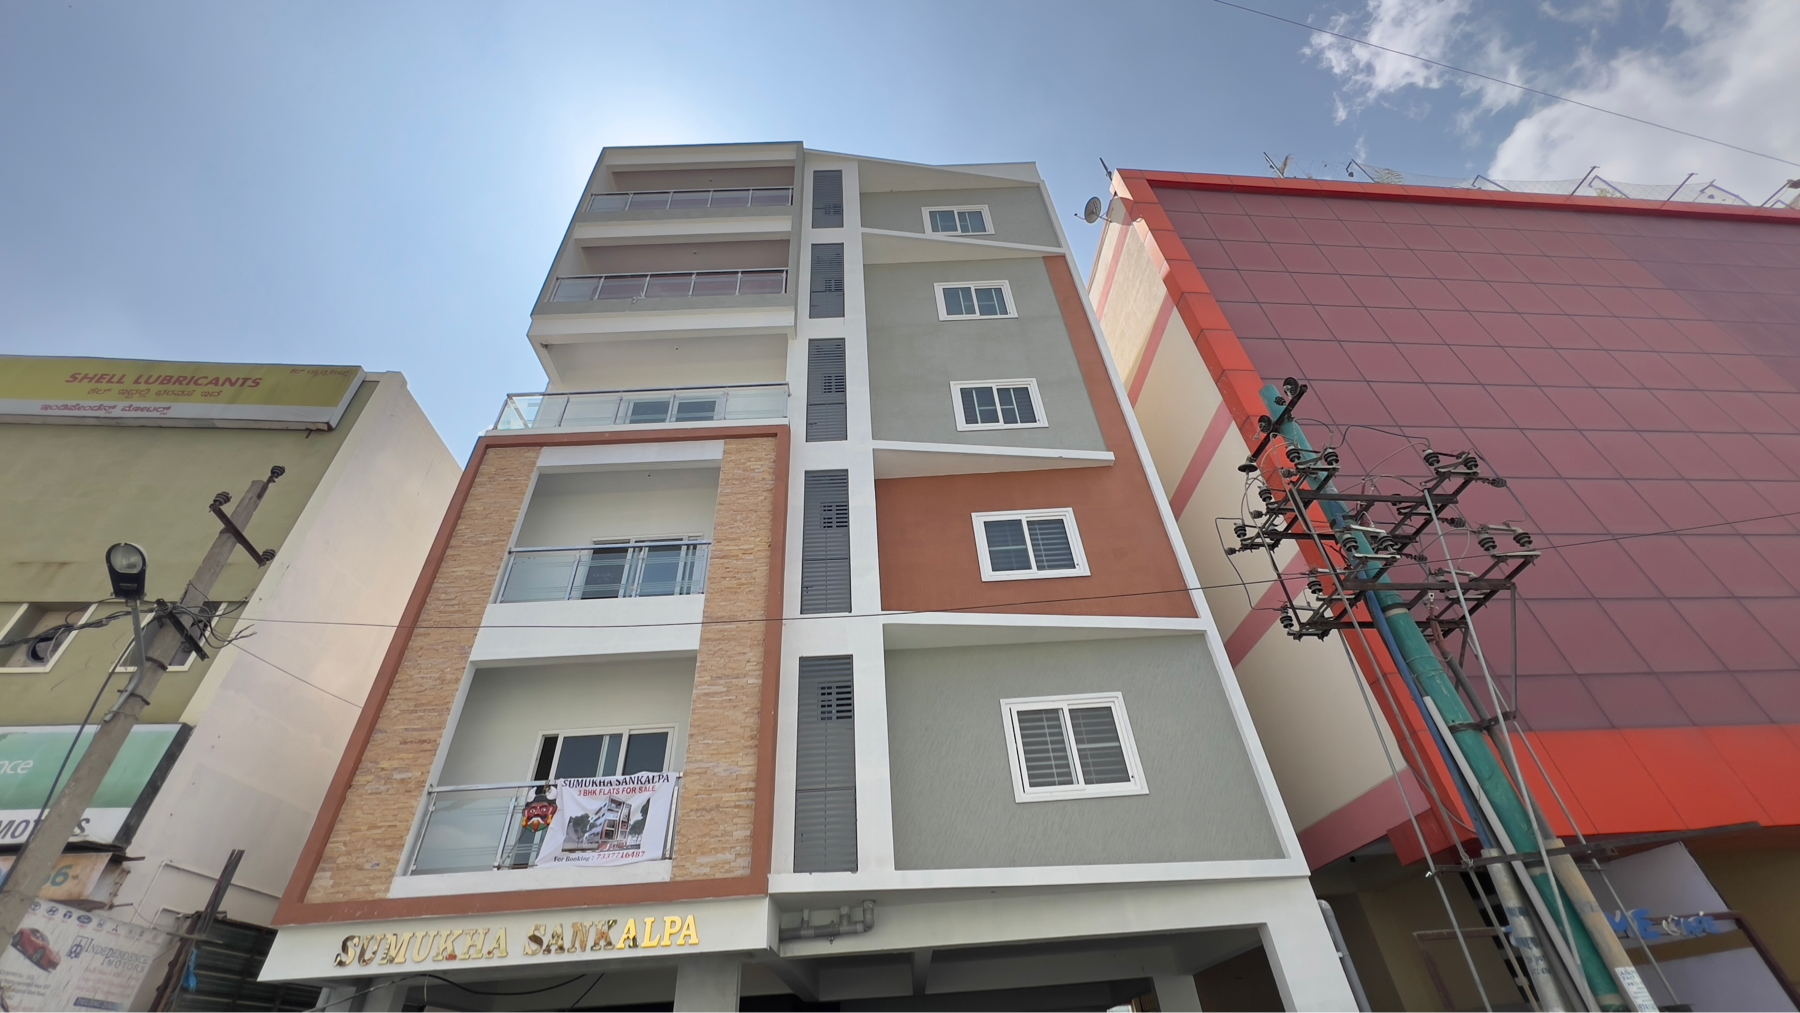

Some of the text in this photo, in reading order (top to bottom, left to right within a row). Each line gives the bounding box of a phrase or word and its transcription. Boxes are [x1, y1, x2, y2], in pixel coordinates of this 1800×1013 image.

[65, 372, 263, 388] SHELL LUBRICANTS
[562, 774, 670, 788] SUMUKHA SANKALPA
[583, 789, 598, 797] BHK
[599, 787, 621, 796] FLATS
[621, 786, 637, 795] FOR
[638, 785, 656, 793] SALE
[565, 855, 590, 864] Booking
[596, 850, 646, 861] 7337716487
[333, 914, 700, 967] SUMUKHA SANKALPA
[107, 958, 147, 974] MOTORS
